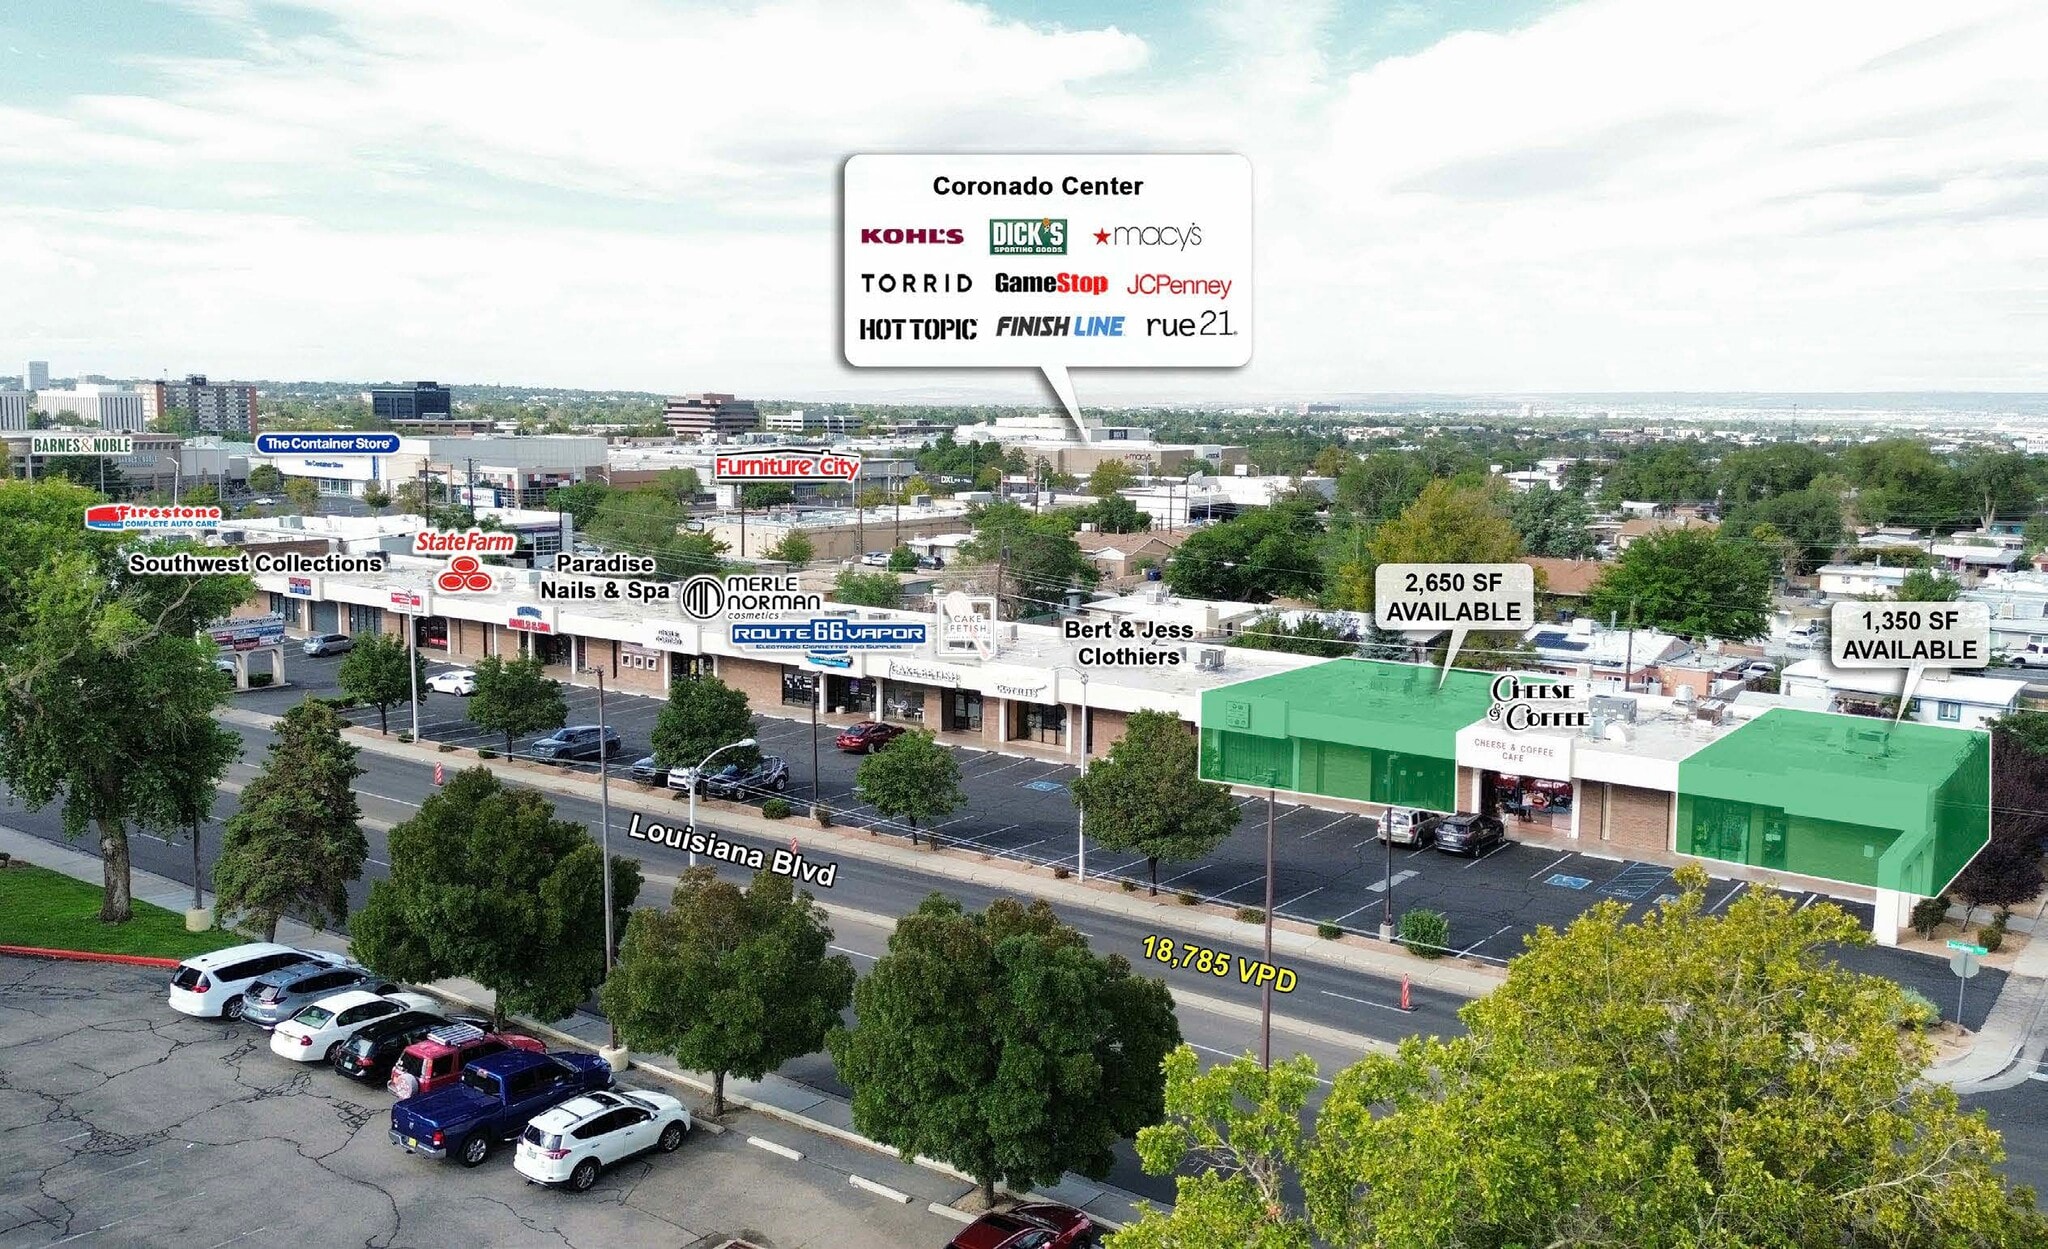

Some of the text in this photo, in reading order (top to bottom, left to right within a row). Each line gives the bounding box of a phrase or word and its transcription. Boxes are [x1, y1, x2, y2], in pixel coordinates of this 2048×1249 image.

[1474, 738, 1507, 750] CHEESE
[1520, 745, 1554, 757] COFFEE
[1502, 752, 1524, 762] CAFE
